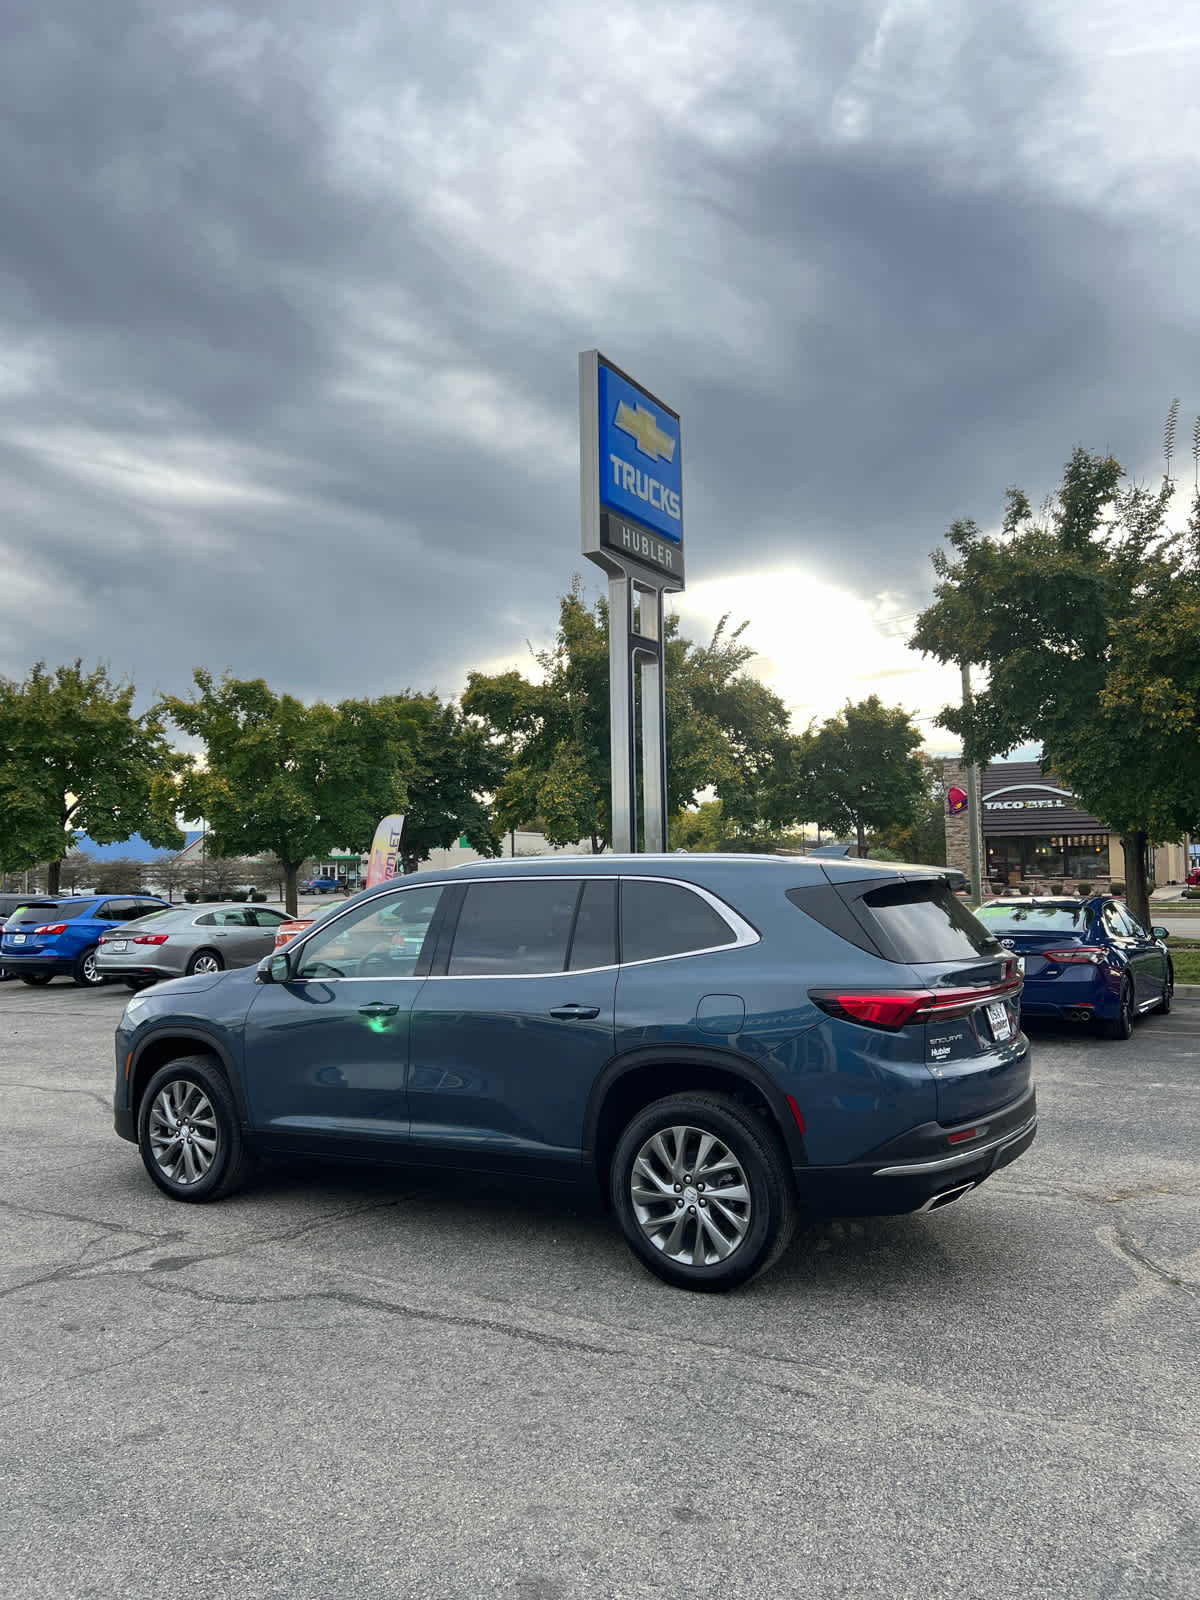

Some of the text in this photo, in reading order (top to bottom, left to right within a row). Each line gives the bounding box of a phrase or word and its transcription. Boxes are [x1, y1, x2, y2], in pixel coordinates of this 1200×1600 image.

[610, 453, 681, 520] TRUCKS
[622, 526, 673, 569] HUBLER
[984, 801, 1024, 809] TACO
[931, 1047, 951, 1056] Hubler
